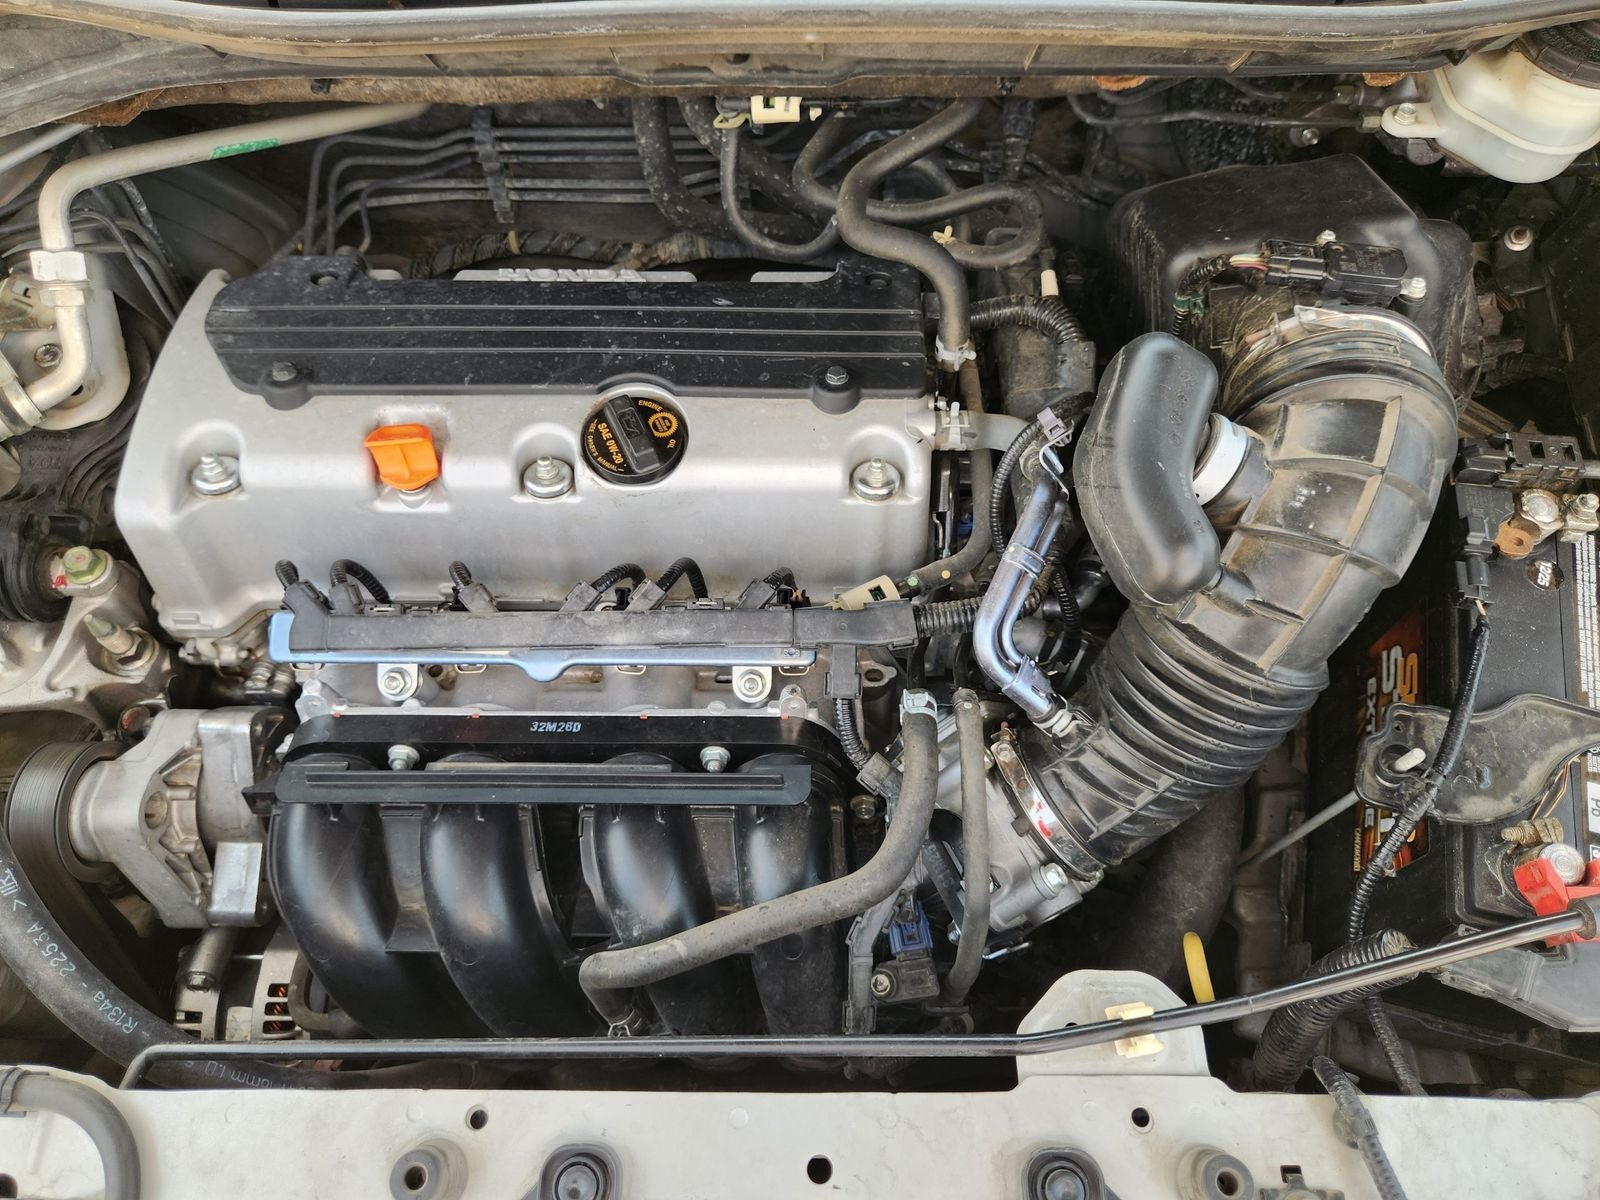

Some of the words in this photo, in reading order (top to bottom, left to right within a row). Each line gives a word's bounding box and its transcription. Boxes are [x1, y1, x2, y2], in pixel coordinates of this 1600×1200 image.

[498, 268, 647, 282] HONDA
[638, 400, 664, 412] ENGINE
[597, 422, 613, 441] SAE
[1537, 560, 1553, 588] 12/25
[26, 920, 77, 978] 2253A
[93, 990, 139, 1034] R134a
